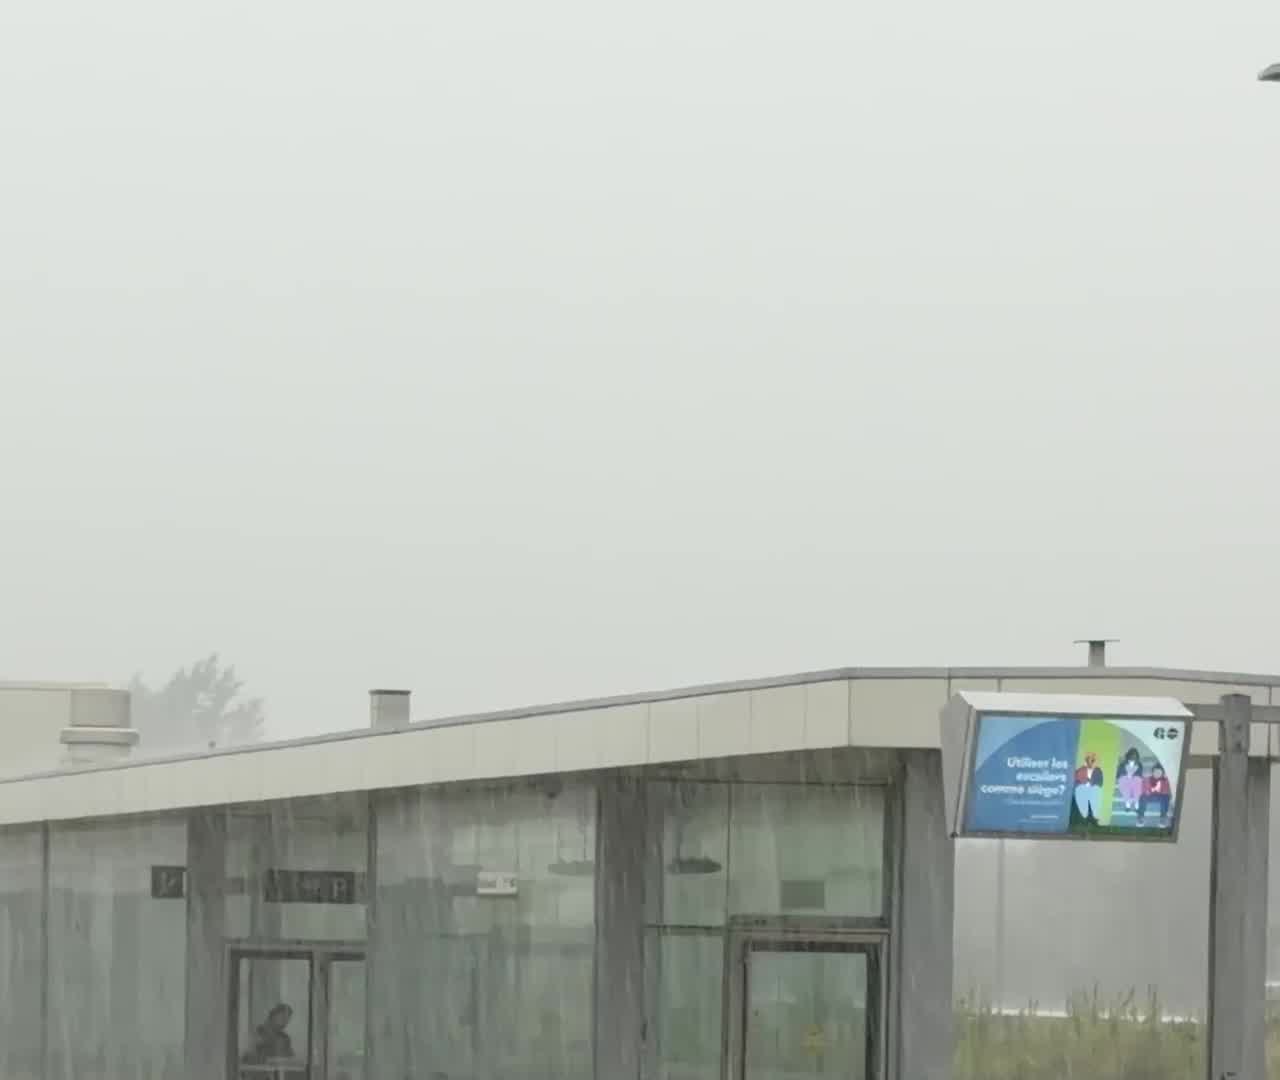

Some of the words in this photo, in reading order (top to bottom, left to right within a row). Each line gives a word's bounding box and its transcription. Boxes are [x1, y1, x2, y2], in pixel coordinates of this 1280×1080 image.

[1153, 727, 1178, 740] GO
[1006, 756, 1049, 769] Utiliser
[1051, 756, 1068, 769] les
[980, 784, 1024, 794] comme
